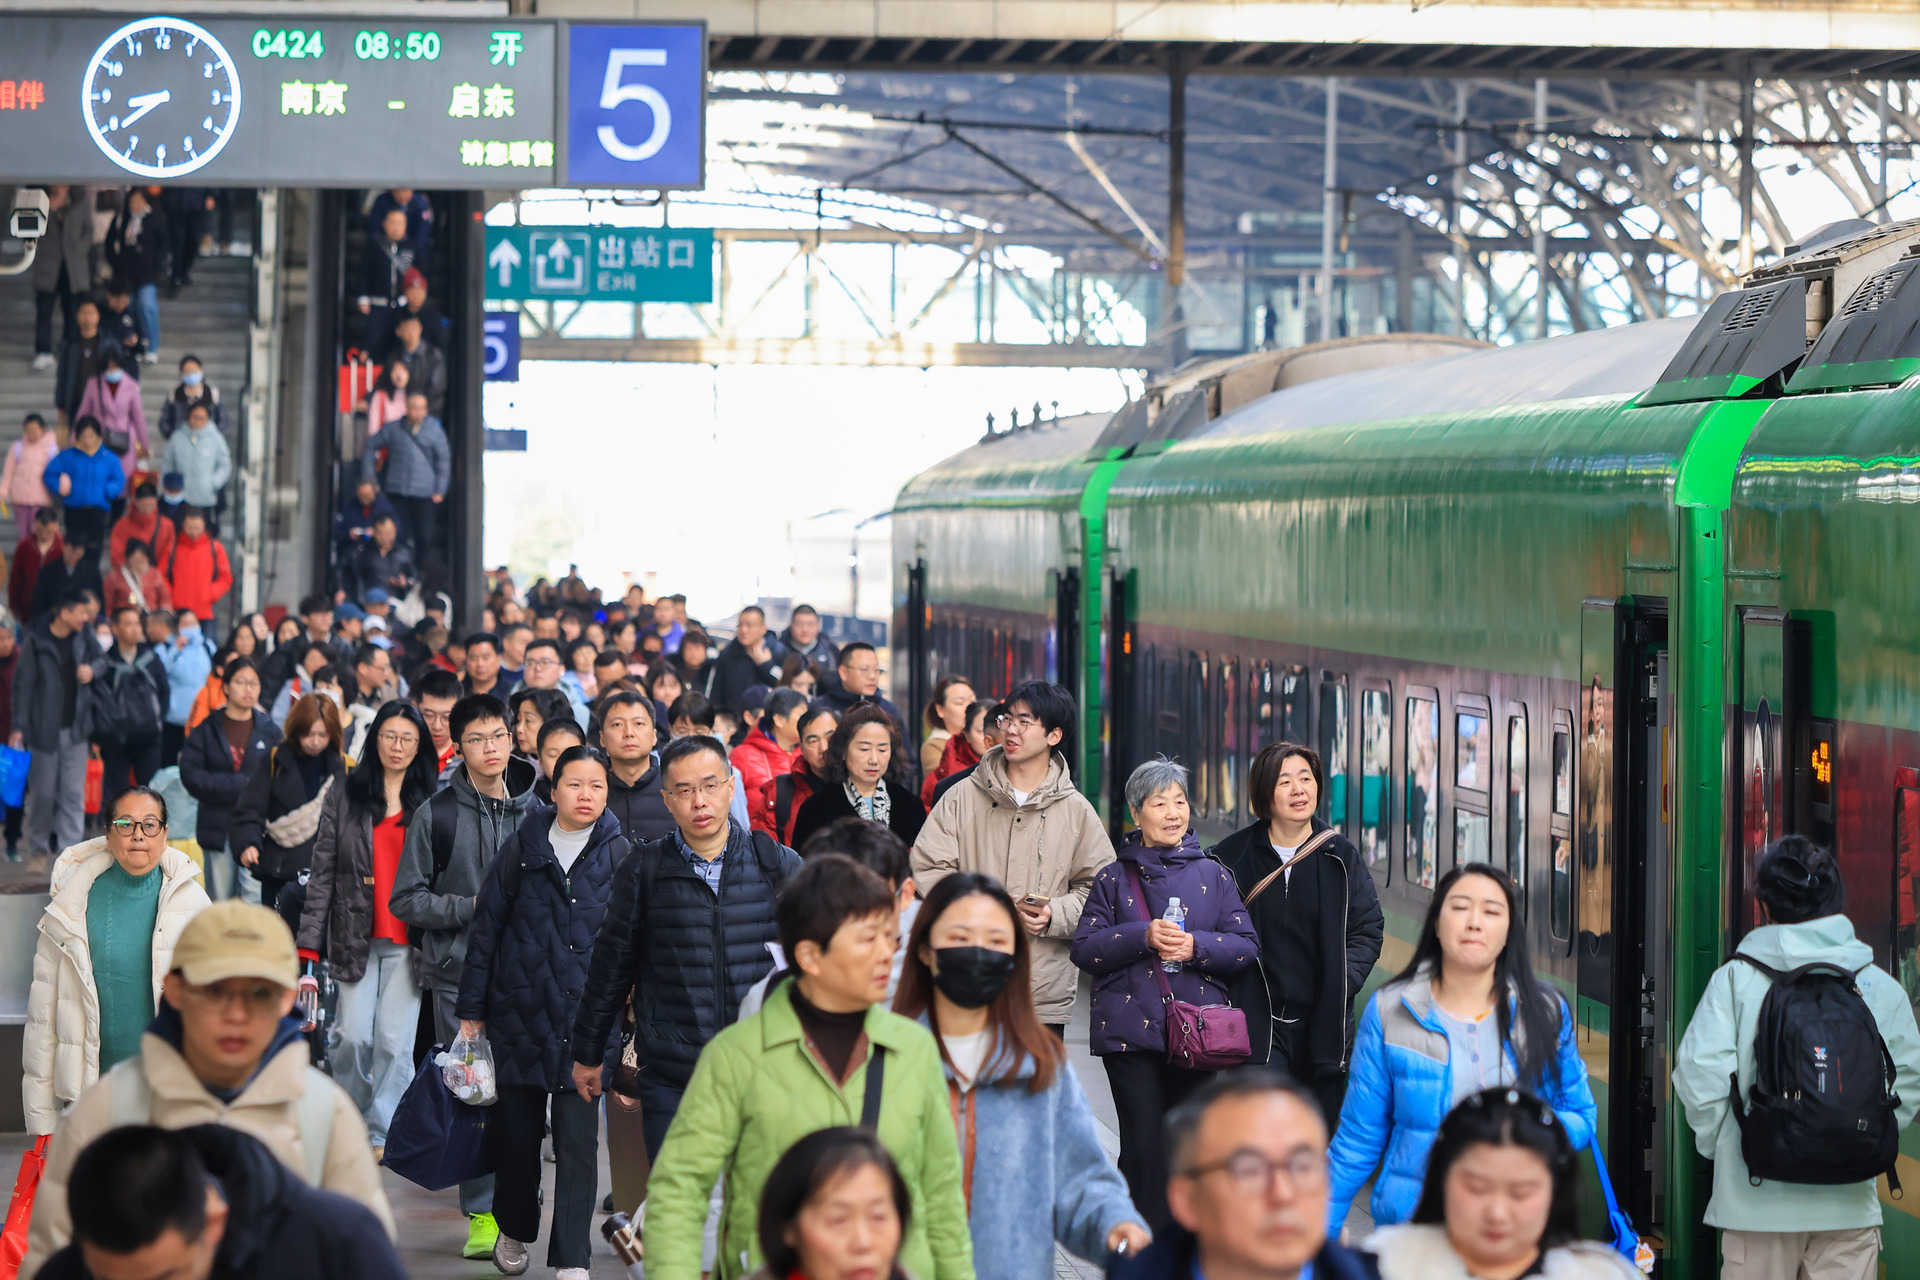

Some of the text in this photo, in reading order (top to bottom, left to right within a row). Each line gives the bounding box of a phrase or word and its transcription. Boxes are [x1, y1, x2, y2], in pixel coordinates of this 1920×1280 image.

[127, 41, 143, 57] 11
[154, 34, 171, 50] 12
[184, 42, 194, 58] 1
[251, 28, 524, 67] C424 08:50 开
[107, 61, 124, 77] 10
[203, 62, 214, 78] 2
[101, 88, 112, 104] 9
[211, 89, 221, 106] 3
[280, 79, 349, 116] 南京
[448, 81, 516, 119] 启东
[597, 48, 672, 162] 5
[201, 115, 214, 132] 4
[129, 134, 139, 151] 7
[182, 135, 194, 152] 5
[598, 234, 695, 270] 出站口
[597, 271, 637, 292] Exit
